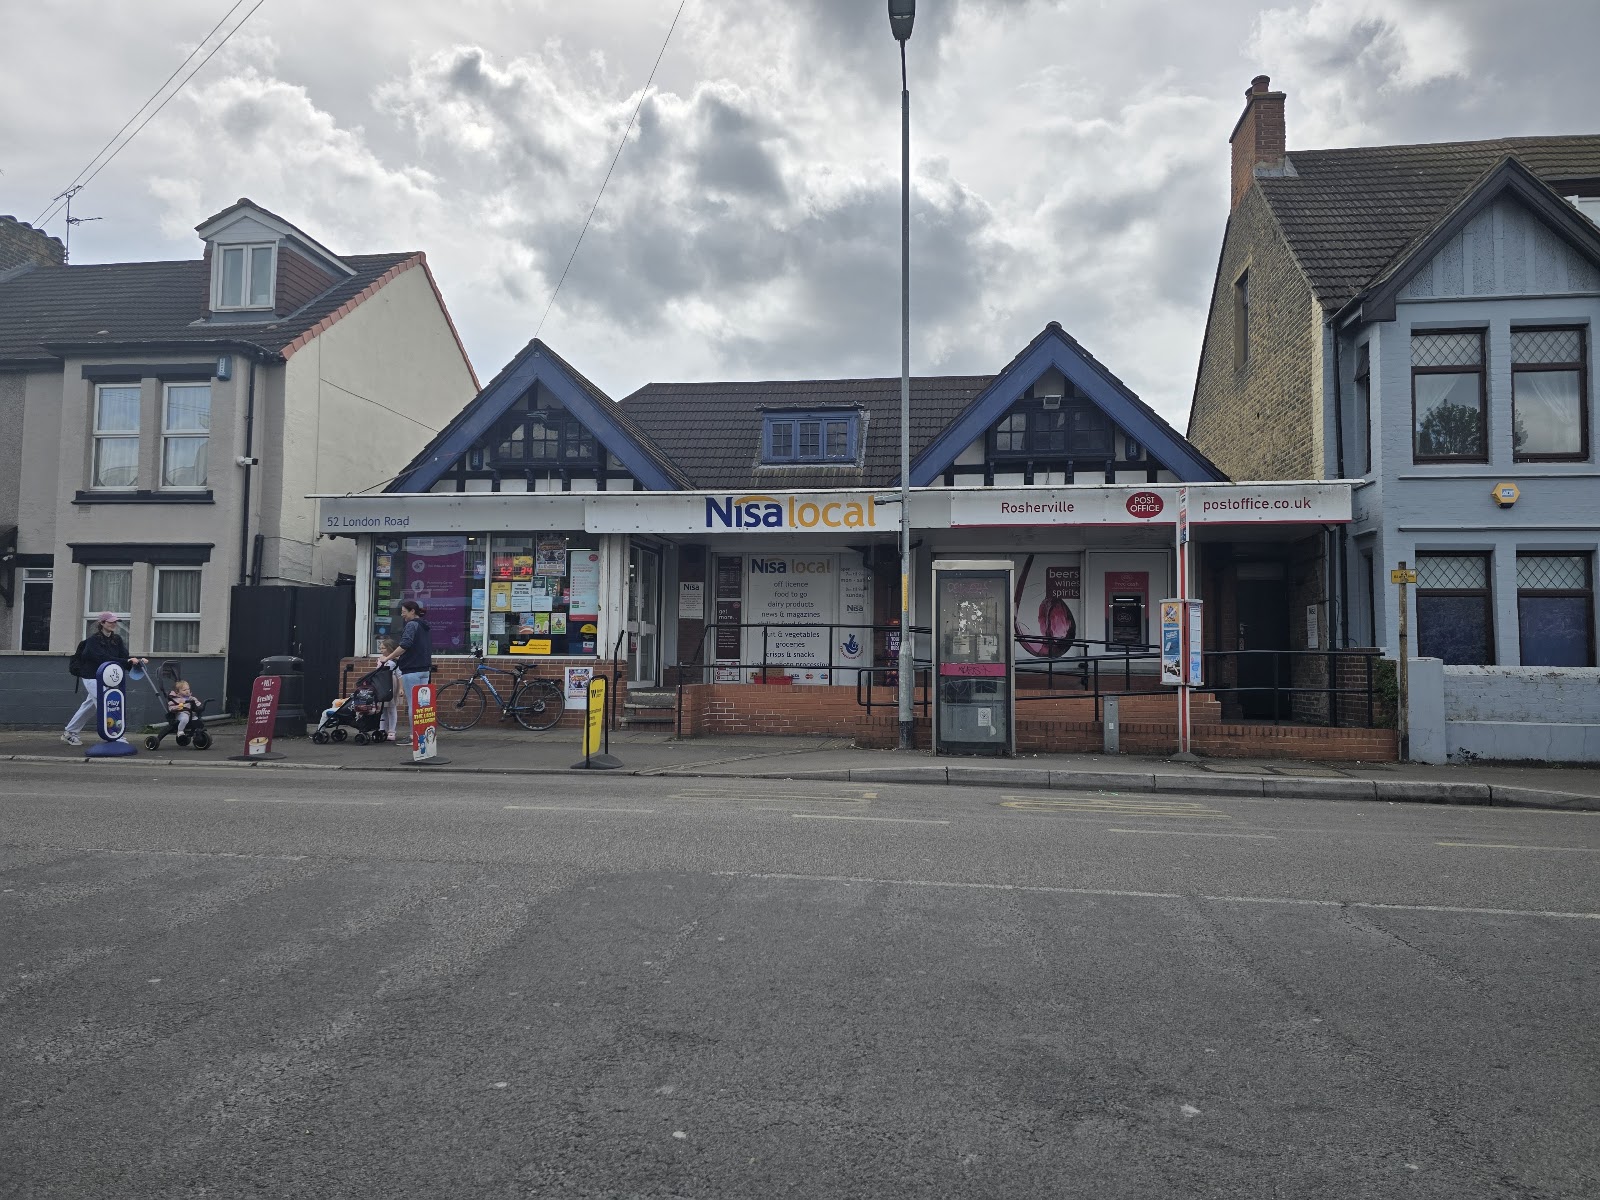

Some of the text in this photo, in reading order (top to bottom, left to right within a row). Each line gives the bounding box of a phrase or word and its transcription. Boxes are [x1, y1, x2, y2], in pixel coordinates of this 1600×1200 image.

[1134, 496, 1154, 504] POST
[1203, 497, 1312, 512] postoffice.co.uk
[705, 495, 876, 528] Nisa local
[1001, 501, 1074, 514] Rosherville
[1130, 504, 1160, 512] OFFICE
[327, 516, 410, 526] 52 London Road
[752, 558, 831, 574] Nisa local
[1049, 569, 1079, 578] beers
[1052, 589, 1079, 598] spirits
[256, 708, 271, 716] coffee
